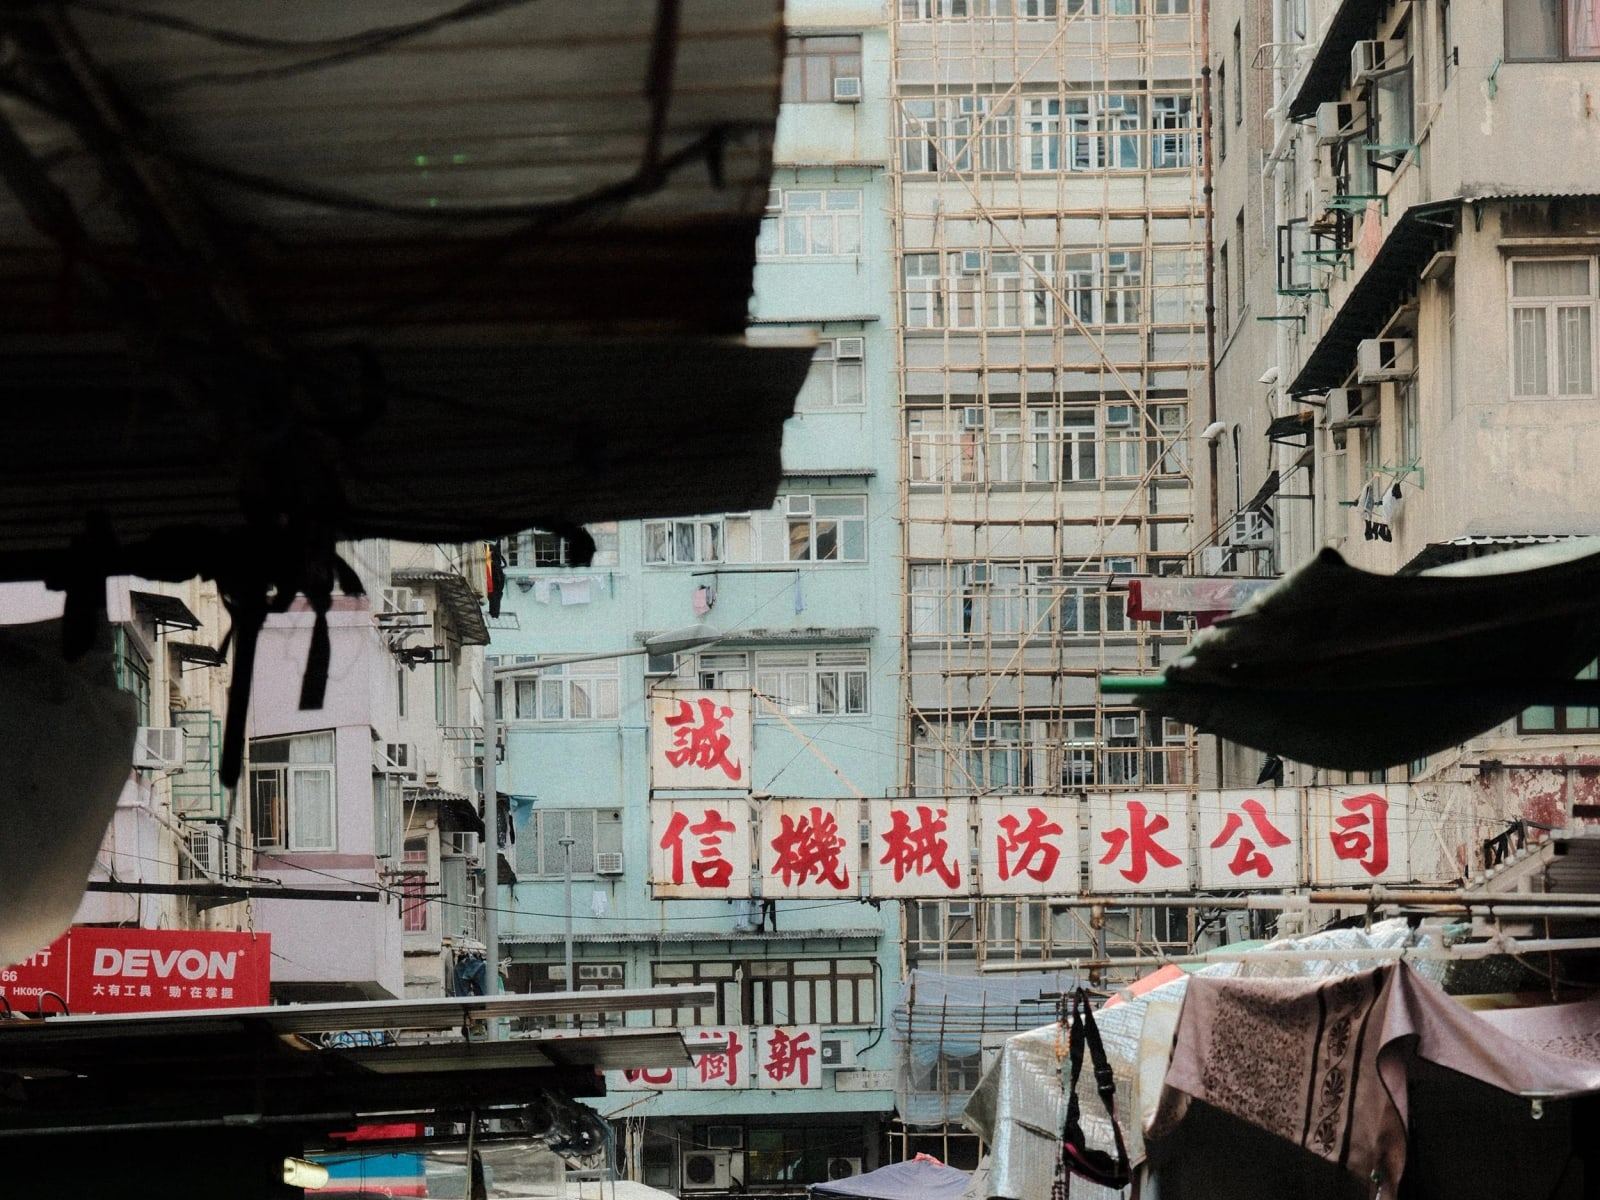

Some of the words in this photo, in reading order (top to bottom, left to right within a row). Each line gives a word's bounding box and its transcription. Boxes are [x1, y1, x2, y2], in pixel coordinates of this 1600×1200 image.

[665, 698, 742, 781] 誠
[660, 793, 1390, 890] 信機械防水公司
[92, 948, 237, 980] DEVON
[93, 984, 152, 997] 大有工具
